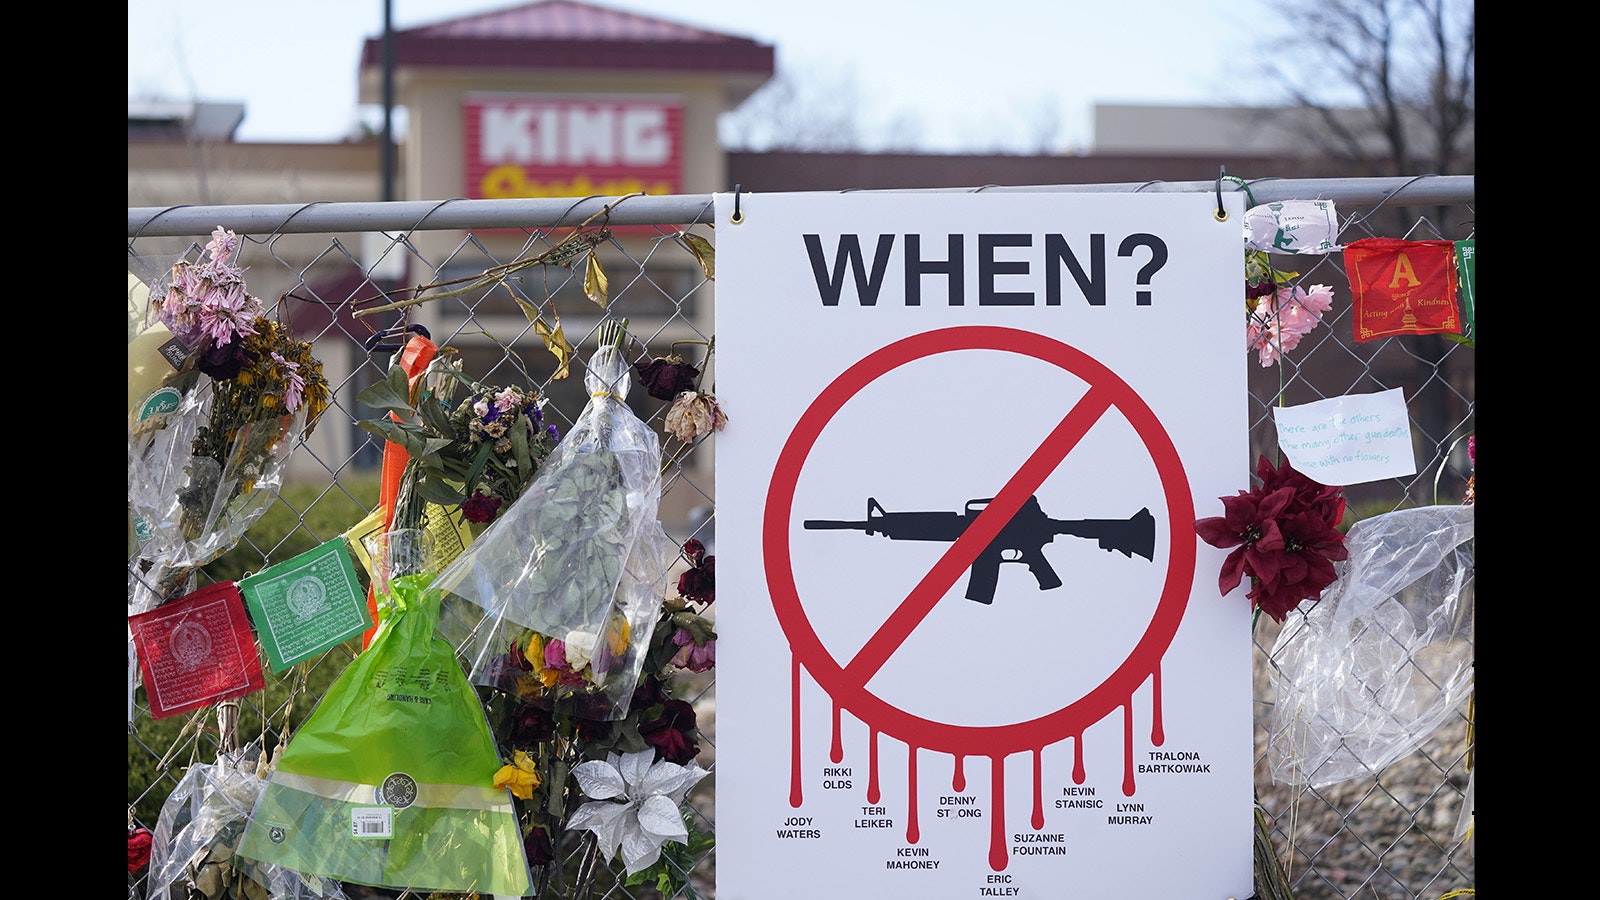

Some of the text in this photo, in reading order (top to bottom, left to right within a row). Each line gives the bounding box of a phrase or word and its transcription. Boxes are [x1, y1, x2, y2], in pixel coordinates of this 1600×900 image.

[480, 105, 672, 166] KING
[803, 233, 1169, 307] WHEN?
[1388, 252, 1422, 288] A
[1277, 412, 1382, 434] There are te others
[1301, 438, 1332, 451] many
[1333, 431, 1361, 445] other
[1319, 453, 1340, 468] with
[1343, 454, 1354, 463] no
[1354, 448, 1391, 464] flowers
[1149, 752, 1201, 761] TRALONA
[824, 768, 852, 777] RIKKI
[1139, 765, 1211, 774] BARTKOWIAK
[823, 781, 853, 790] OLDS
[1063, 788, 1095, 797] NEVIN
[940, 797, 977, 806] DENNY
[1055, 800, 1104, 809] STANISIC
[862, 807, 886, 816] TERI
[1117, 804, 1144, 813] LYNN
[937, 809, 982, 818] STONG
[785, 818, 813, 827] JODY
[855, 820, 893, 828] LEIKER
[1108, 816, 1153, 825] MURRAY
[777, 830, 821, 839] WATERS
[1014, 834, 1065, 843] SUZANNE
[897, 848, 929, 857] KEVIN
[1013, 847, 1066, 856] FOUNTAIN
[887, 861, 940, 870] MAHONEY
[987, 875, 1012, 884] ERIC
[980, 888, 1020, 897] TALLEY
